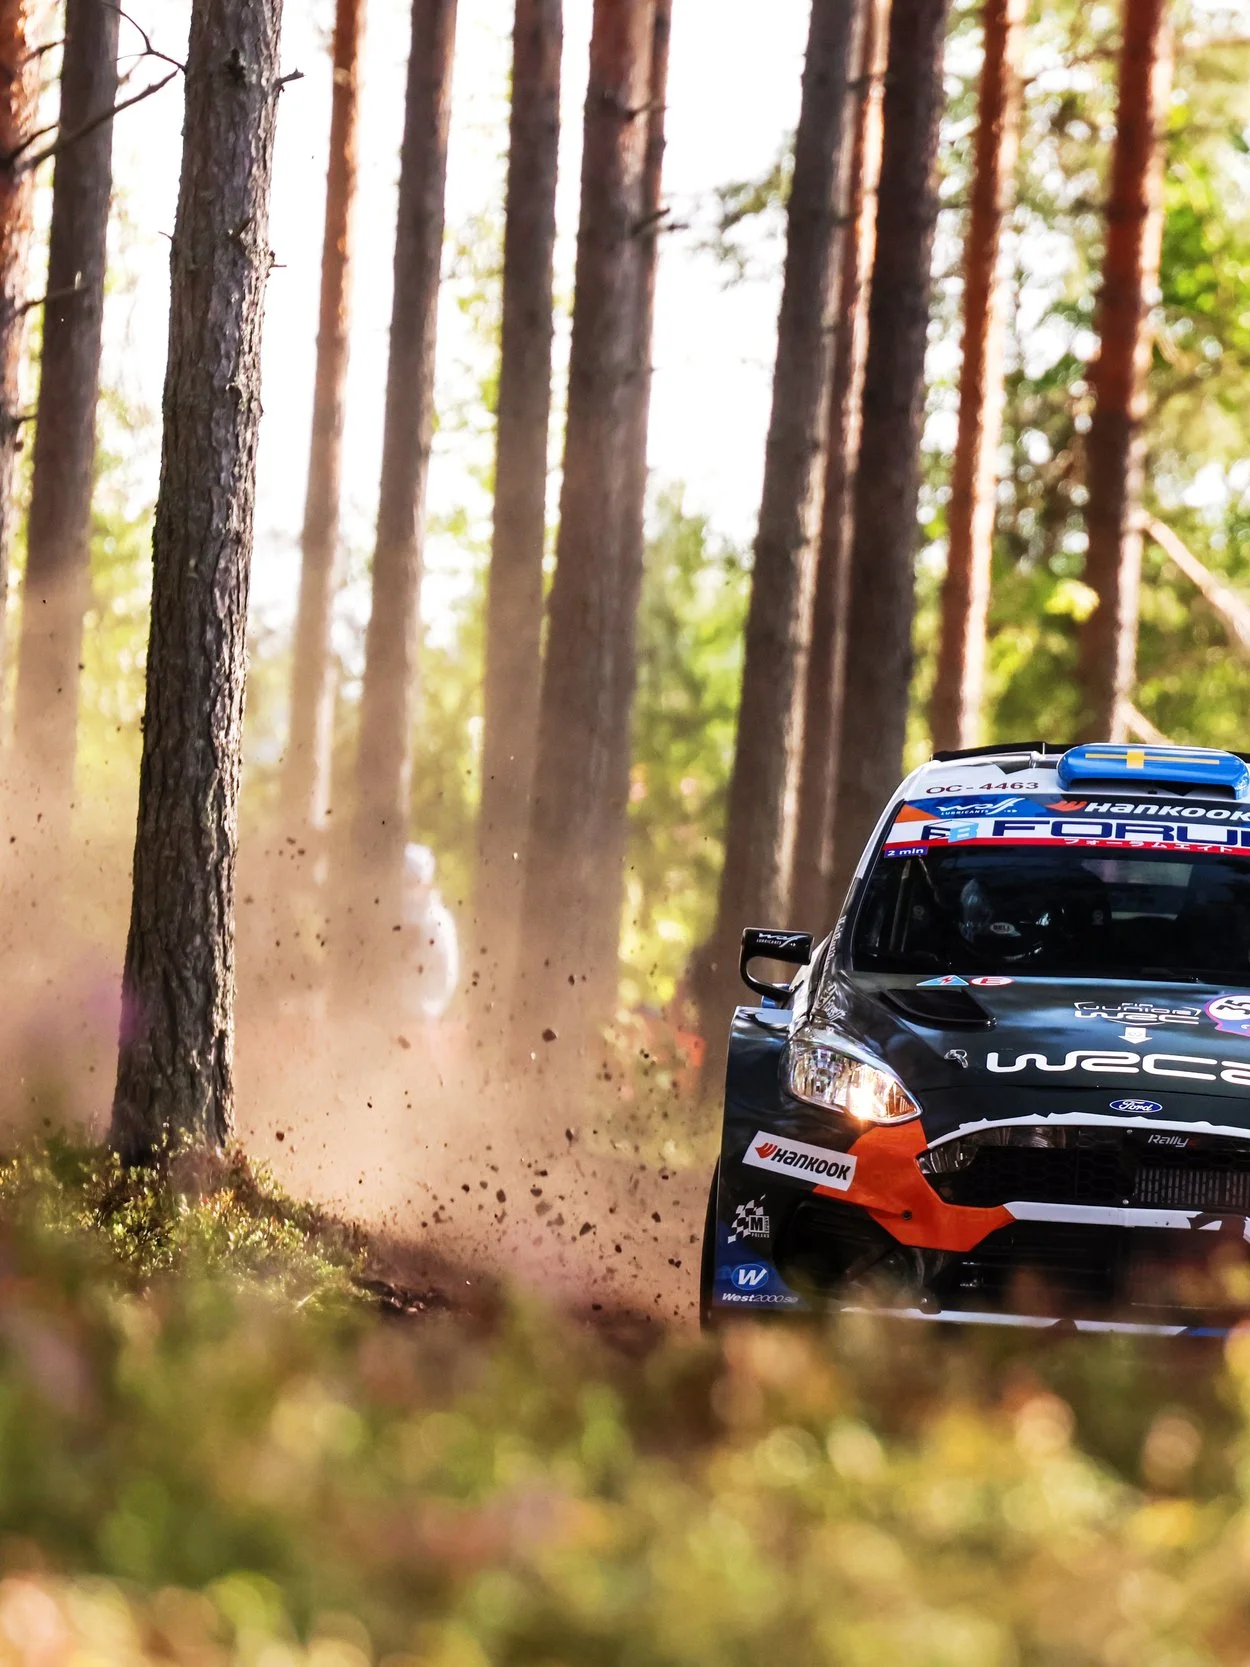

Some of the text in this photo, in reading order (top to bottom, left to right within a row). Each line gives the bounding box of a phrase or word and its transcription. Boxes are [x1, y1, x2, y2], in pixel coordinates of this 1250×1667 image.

[887, 847, 925, 857] 2 min
[1063, 838, 1233, 853] フォーラムエイト
[1118, 1100, 1154, 1112] Ford
[750, 1217, 764, 1232] M
[738, 1269, 768, 1286] W
